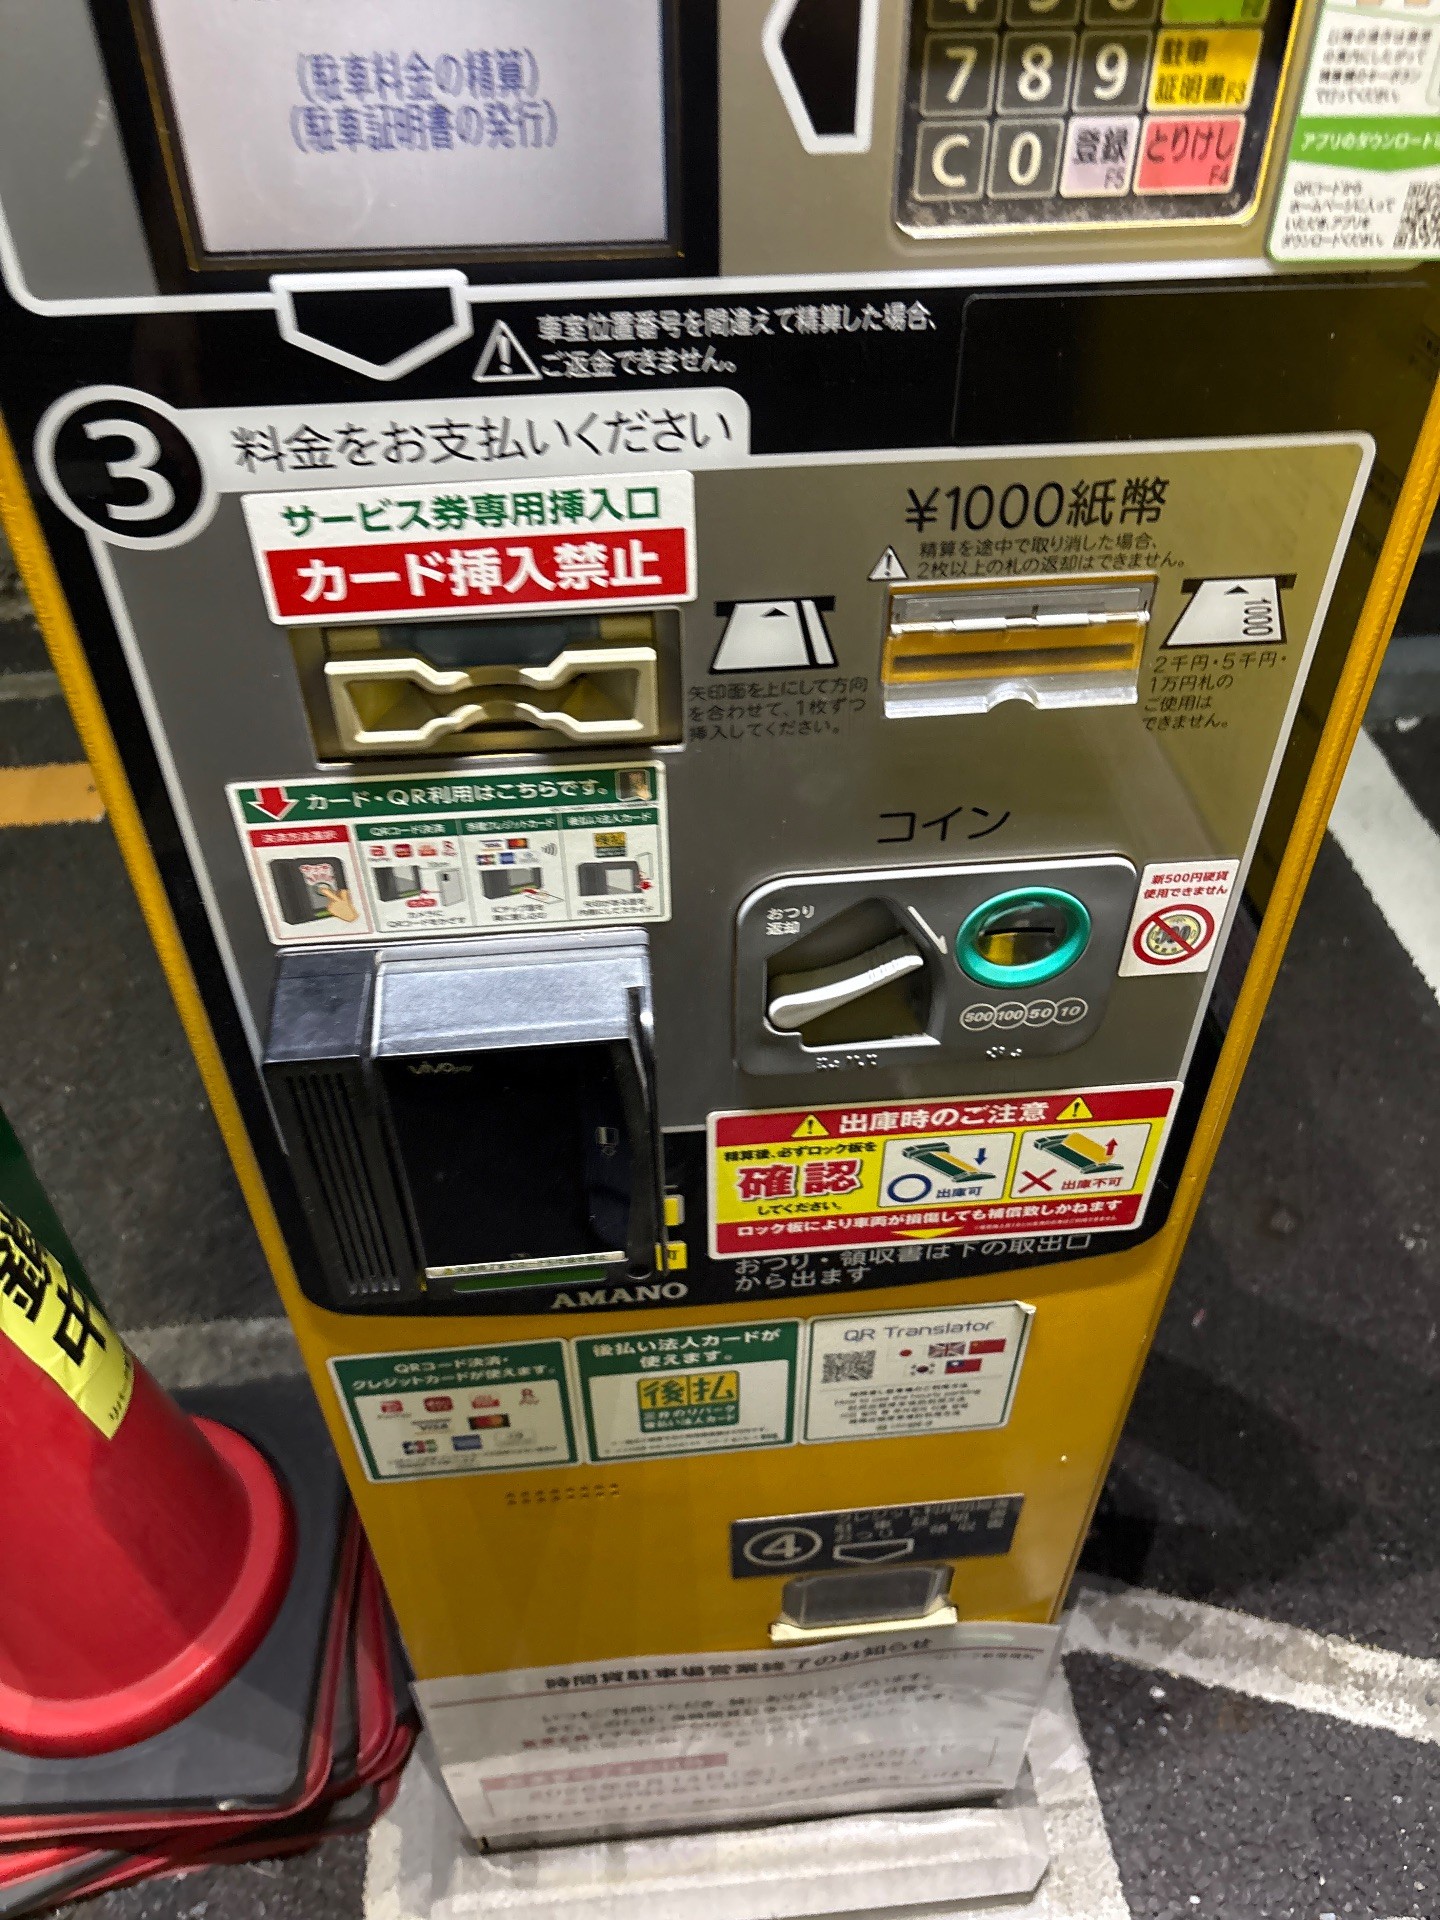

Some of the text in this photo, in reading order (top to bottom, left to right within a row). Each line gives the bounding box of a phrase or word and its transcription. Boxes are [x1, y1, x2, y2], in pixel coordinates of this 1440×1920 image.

[945, 47, 977, 102] 7
[1017, 44, 1053, 101] 8
[1093, 44, 1128, 101] 9
[1074, 129, 1128, 164] 登録
[1145, 124, 1236, 163] とりけし
[932, 134, 970, 187] C
[1008, 131, 1042, 186] 0
[1208, 166, 1229, 187] F4
[537, 300, 938, 343] 車室位置番号を間違えて精算した場合、
[540, 346, 738, 379] ご返金できません。
[231, 408, 731, 476] 料金をお支払いください
[82, 418, 177, 522] 3
[283, 486, 661, 538] サービス券専用挿入口
[919, 531, 1158, 559] 精算を途中で取り消した場合、
[297, 541, 663, 605] カード挿入禁止
[917, 553, 1186, 580] 2枚以上の札の返却はできません。
[689, 676, 869, 701] 矢印面を上にして方向
[1150, 675, 1234, 692] 1万円札の
[689, 699, 866, 722] を合わせて、1枚ずつ
[1144, 694, 1213, 712] ご使用は
[1142, 714, 1229, 731] できません。
[305, 779, 609, 813] カード・QR利用はこちらです。
[876, 806, 1011, 844] コイン
[1151, 870, 1230, 885] 新500円硬貨
[1143, 885, 1228, 900] 使用できません
[766, 905, 815, 921] おつり
[964, 1005, 1082, 1023] 500 100 50 10
[838, 1100, 1049, 1135] 出庫時のご注意
[724, 1140, 878, 1162] 精算後、必ずロック板を
[736, 1158, 863, 1202] 確認
[936, 1185, 983, 1199] 出庫可
[1061, 1176, 1124, 1190] 出庫不可
[737, 1199, 1123, 1238] ロック板により車両が損傷しても補償致しかねます
[756, 1200, 843, 1216] してください。
[734, 1266, 871, 1293] から出ます
[551, 1281, 689, 1309] AMANO
[592, 1327, 781, 1358] 後払い法人カードが
[843, 1319, 995, 1342] QR Translator
[640, 1350, 734, 1370] 使えます。
[351, 1364, 556, 1392] クレジットカードが使えます。
[642, 1374, 735, 1407] 後払
[763, 1534, 801, 1559] 4
